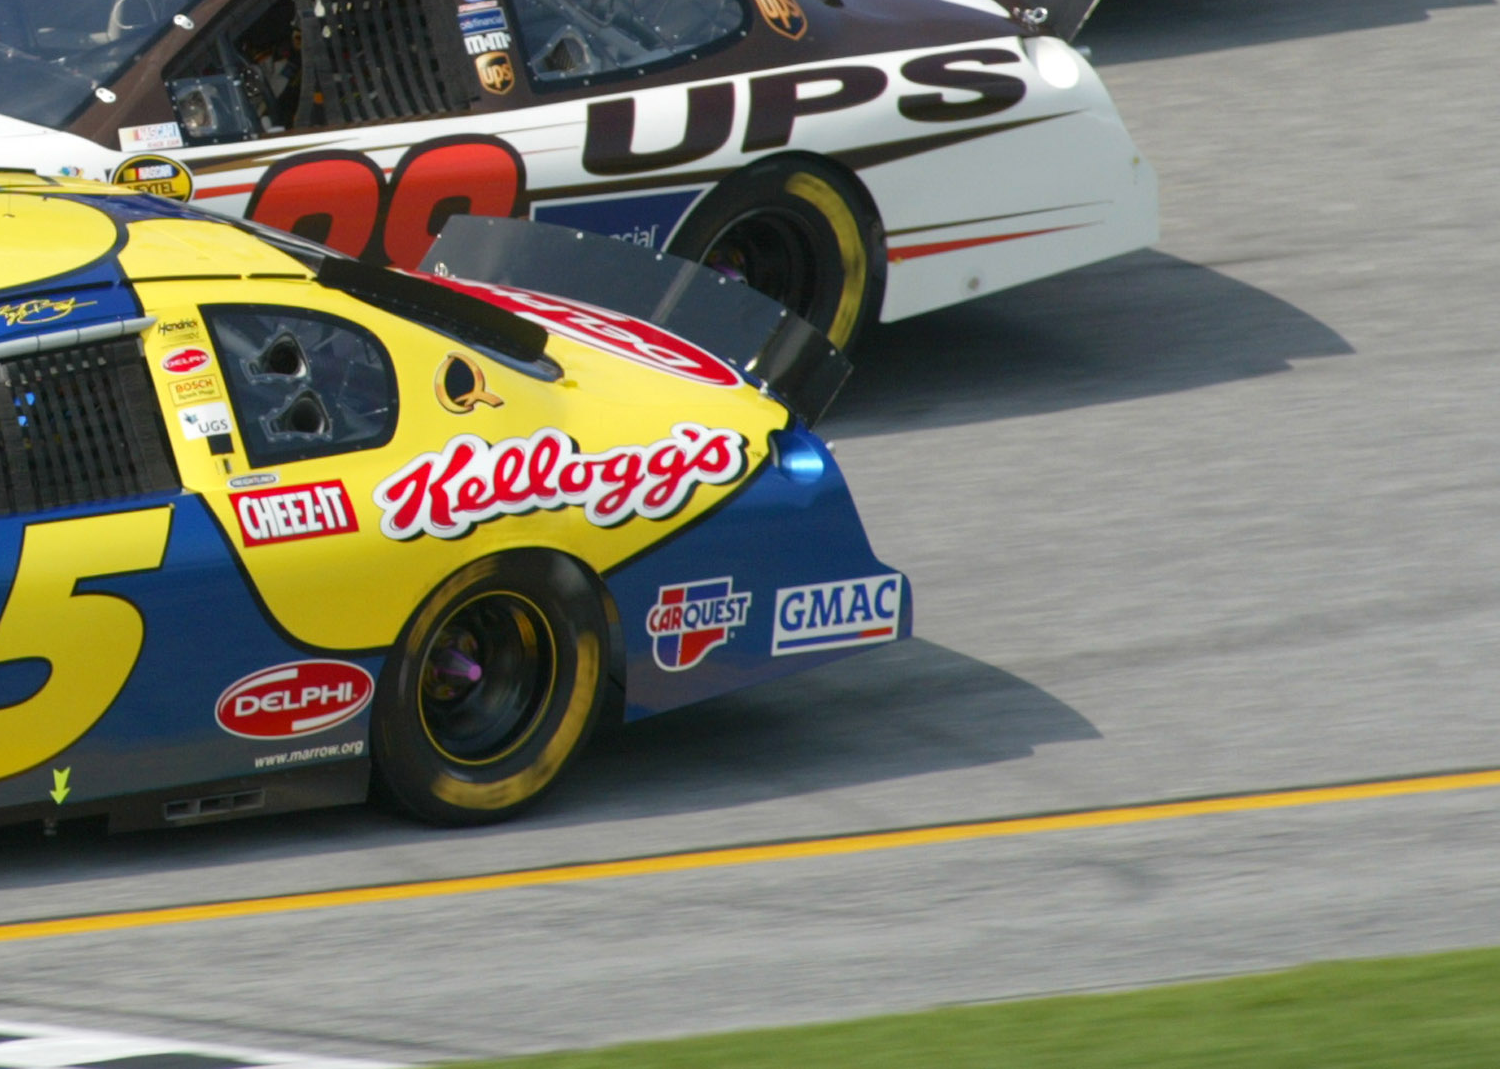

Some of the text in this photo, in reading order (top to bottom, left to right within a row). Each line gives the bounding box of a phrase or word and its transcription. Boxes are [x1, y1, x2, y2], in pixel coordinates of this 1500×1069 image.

[582, 48, 1026, 176] UPS
[175, 379, 213, 393] BOSCH
[198, 419, 229, 433] UGS
[376, 424, 743, 537] Kellogg's
[238, 486, 348, 539] CHEEZ-IT
[649, 597, 748, 632] CARQUEST
[779, 579, 897, 632] GMAC
[235, 681, 353, 717] DELPHI
[255, 740, 364, 768] www.marrow.org
